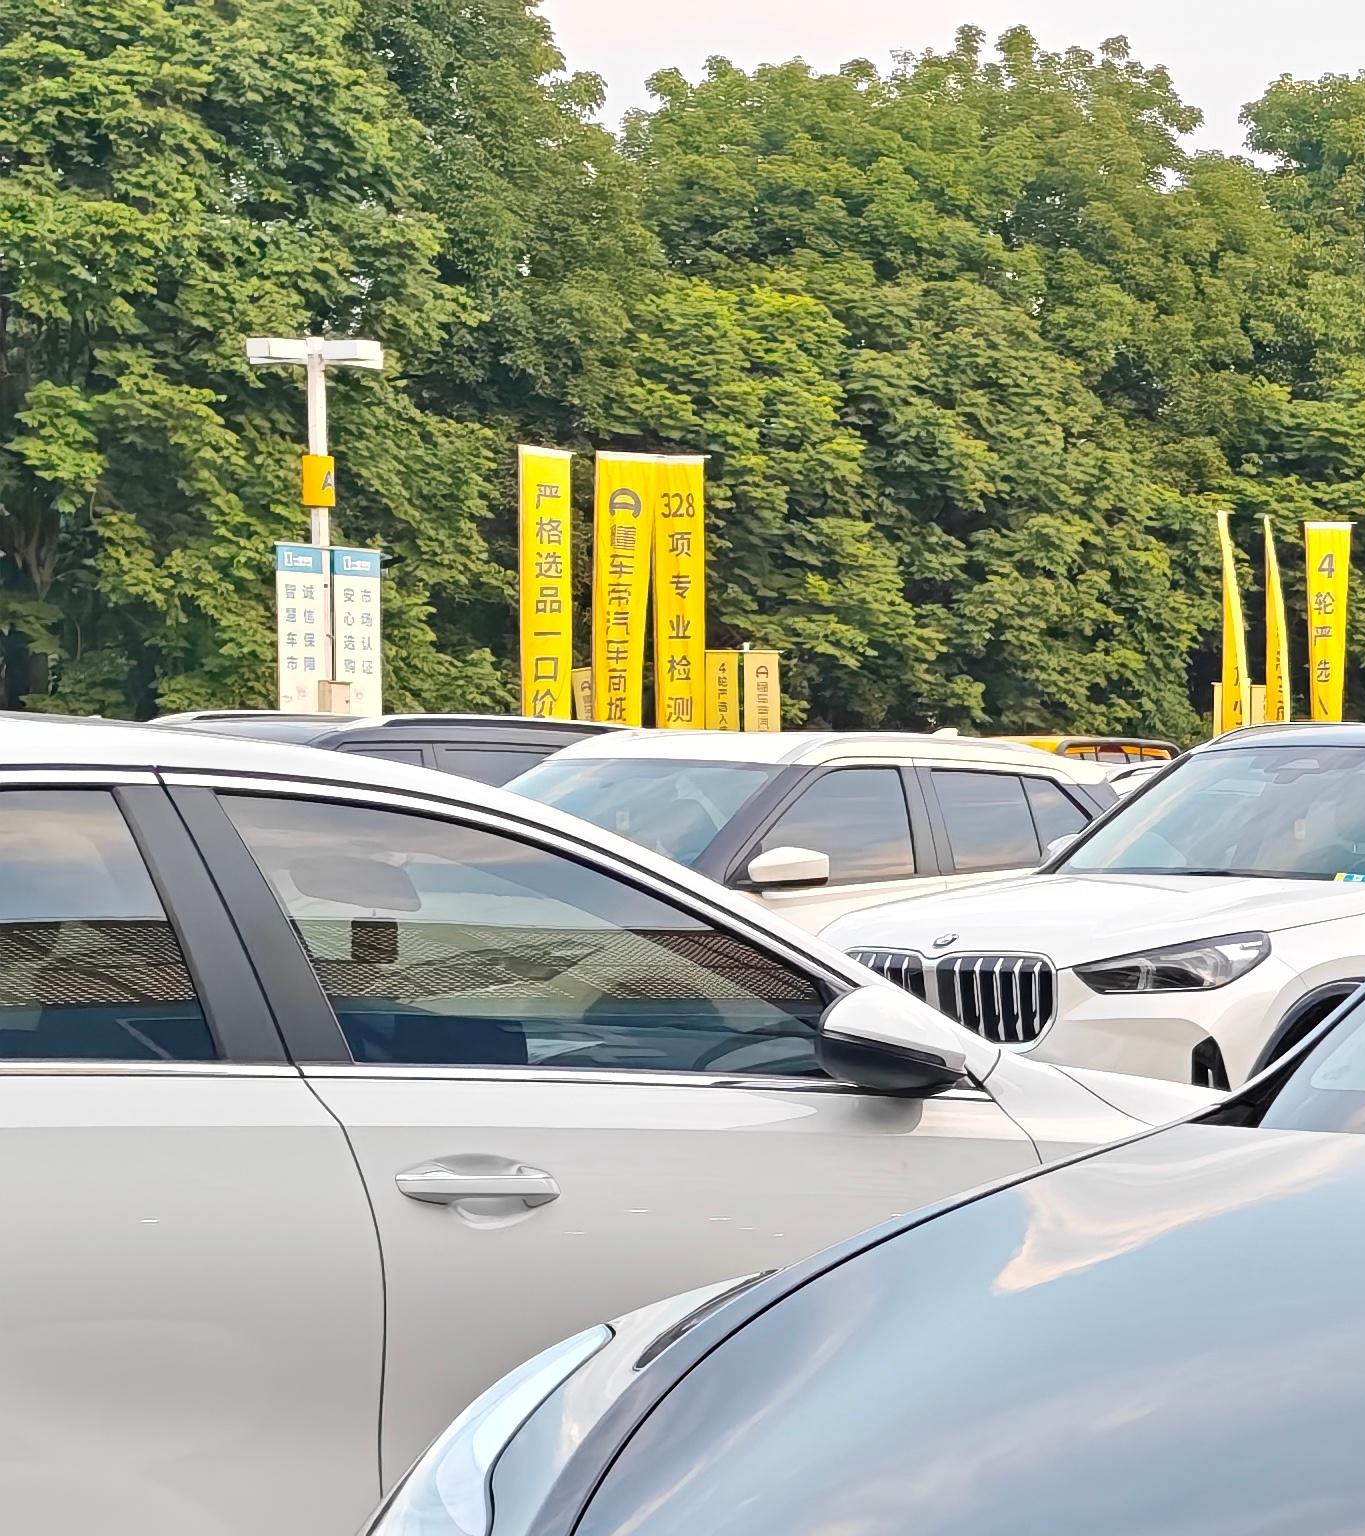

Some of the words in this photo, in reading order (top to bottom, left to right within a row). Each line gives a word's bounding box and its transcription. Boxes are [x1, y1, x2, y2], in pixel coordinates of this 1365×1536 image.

[532, 484, 563, 719] 严格选品一口价
